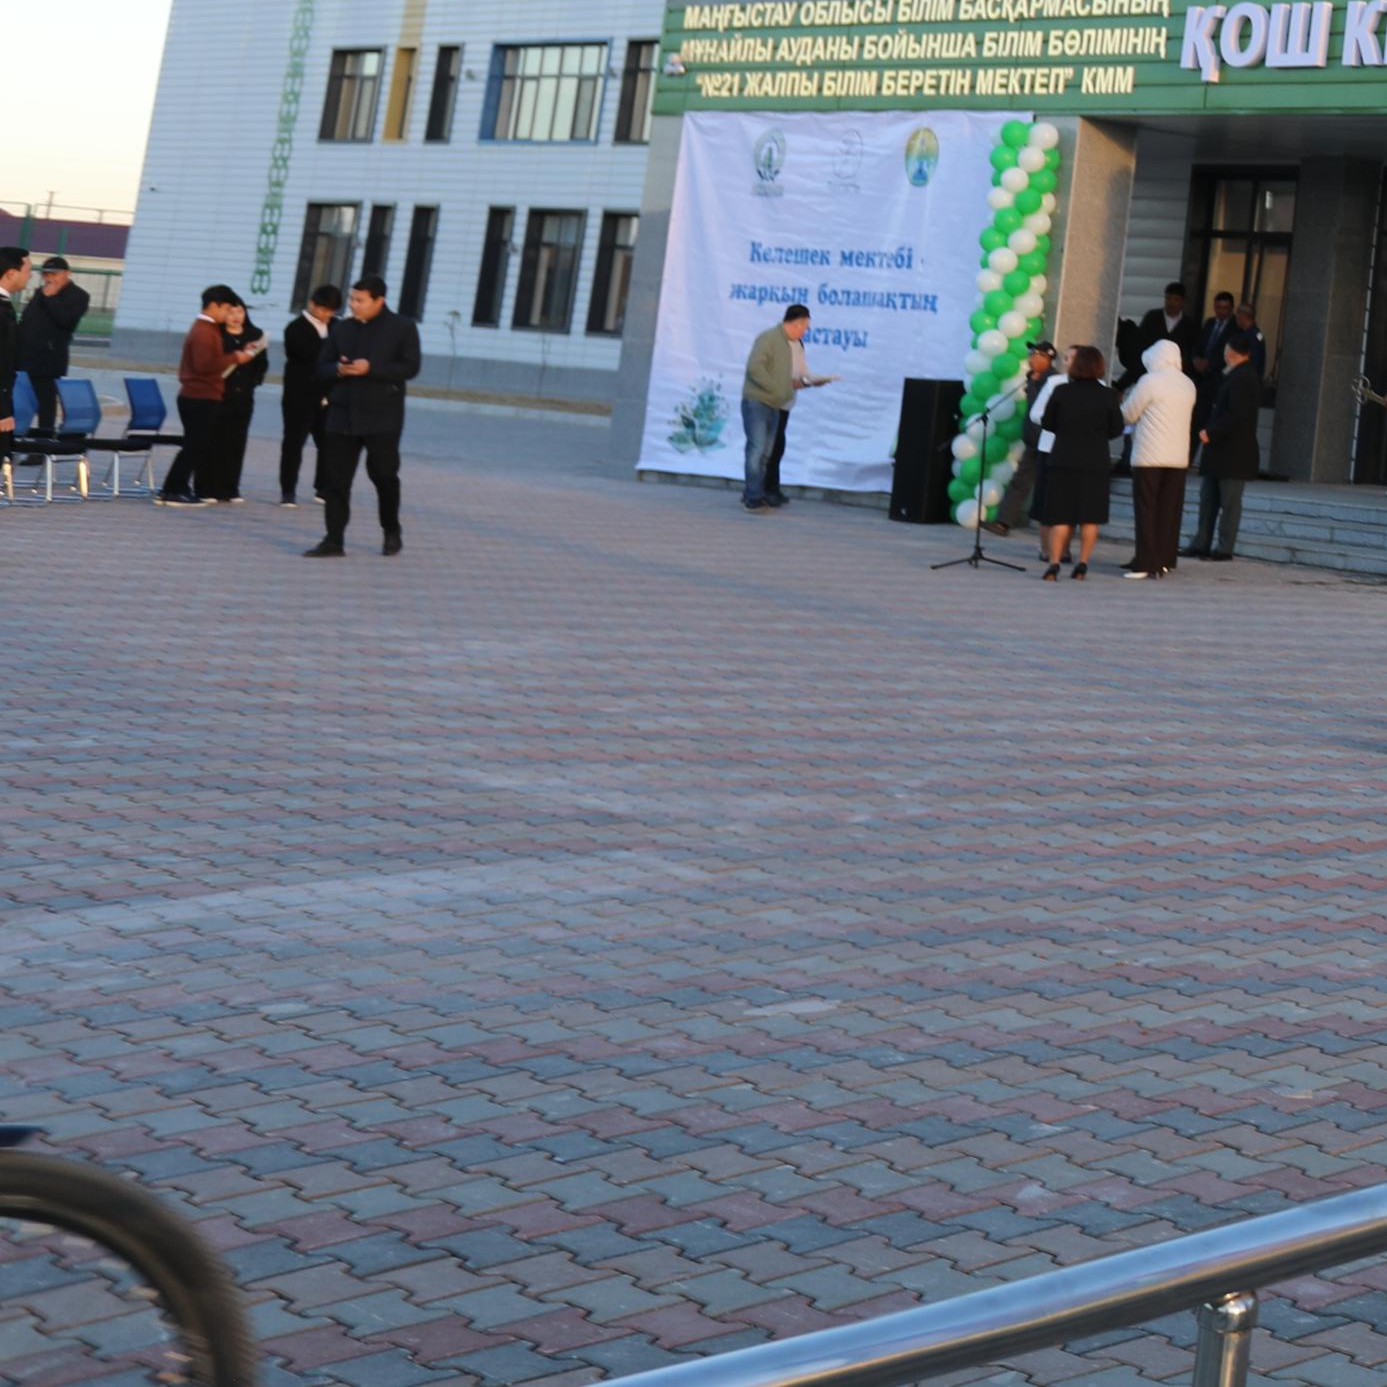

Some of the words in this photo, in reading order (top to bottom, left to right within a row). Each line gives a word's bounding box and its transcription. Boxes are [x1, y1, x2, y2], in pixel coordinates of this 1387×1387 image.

[683, 1, 798, 33] МАҢҒЫСТАУ
[775, 35, 860, 66] АУДАНЫ
[863, 28, 977, 60] БОЙЫНША
[982, 30, 1043, 58] БІЛІМ
[1048, 26, 1167, 59] БӨЛІМІНІҢ
[1180, 1, 1333, 82] ҚОШ
[743, 70, 819, 98] ЖАЛПЫ
[822, 70, 878, 97] БІЛІМ
[881, 68, 972, 96] БЕРЕТІН
[1081, 66, 1136, 94] КММ
[749, 241, 831, 265] Келешек
[839, 245, 914, 270] мектебі
[802, 325, 869, 351] астауы
